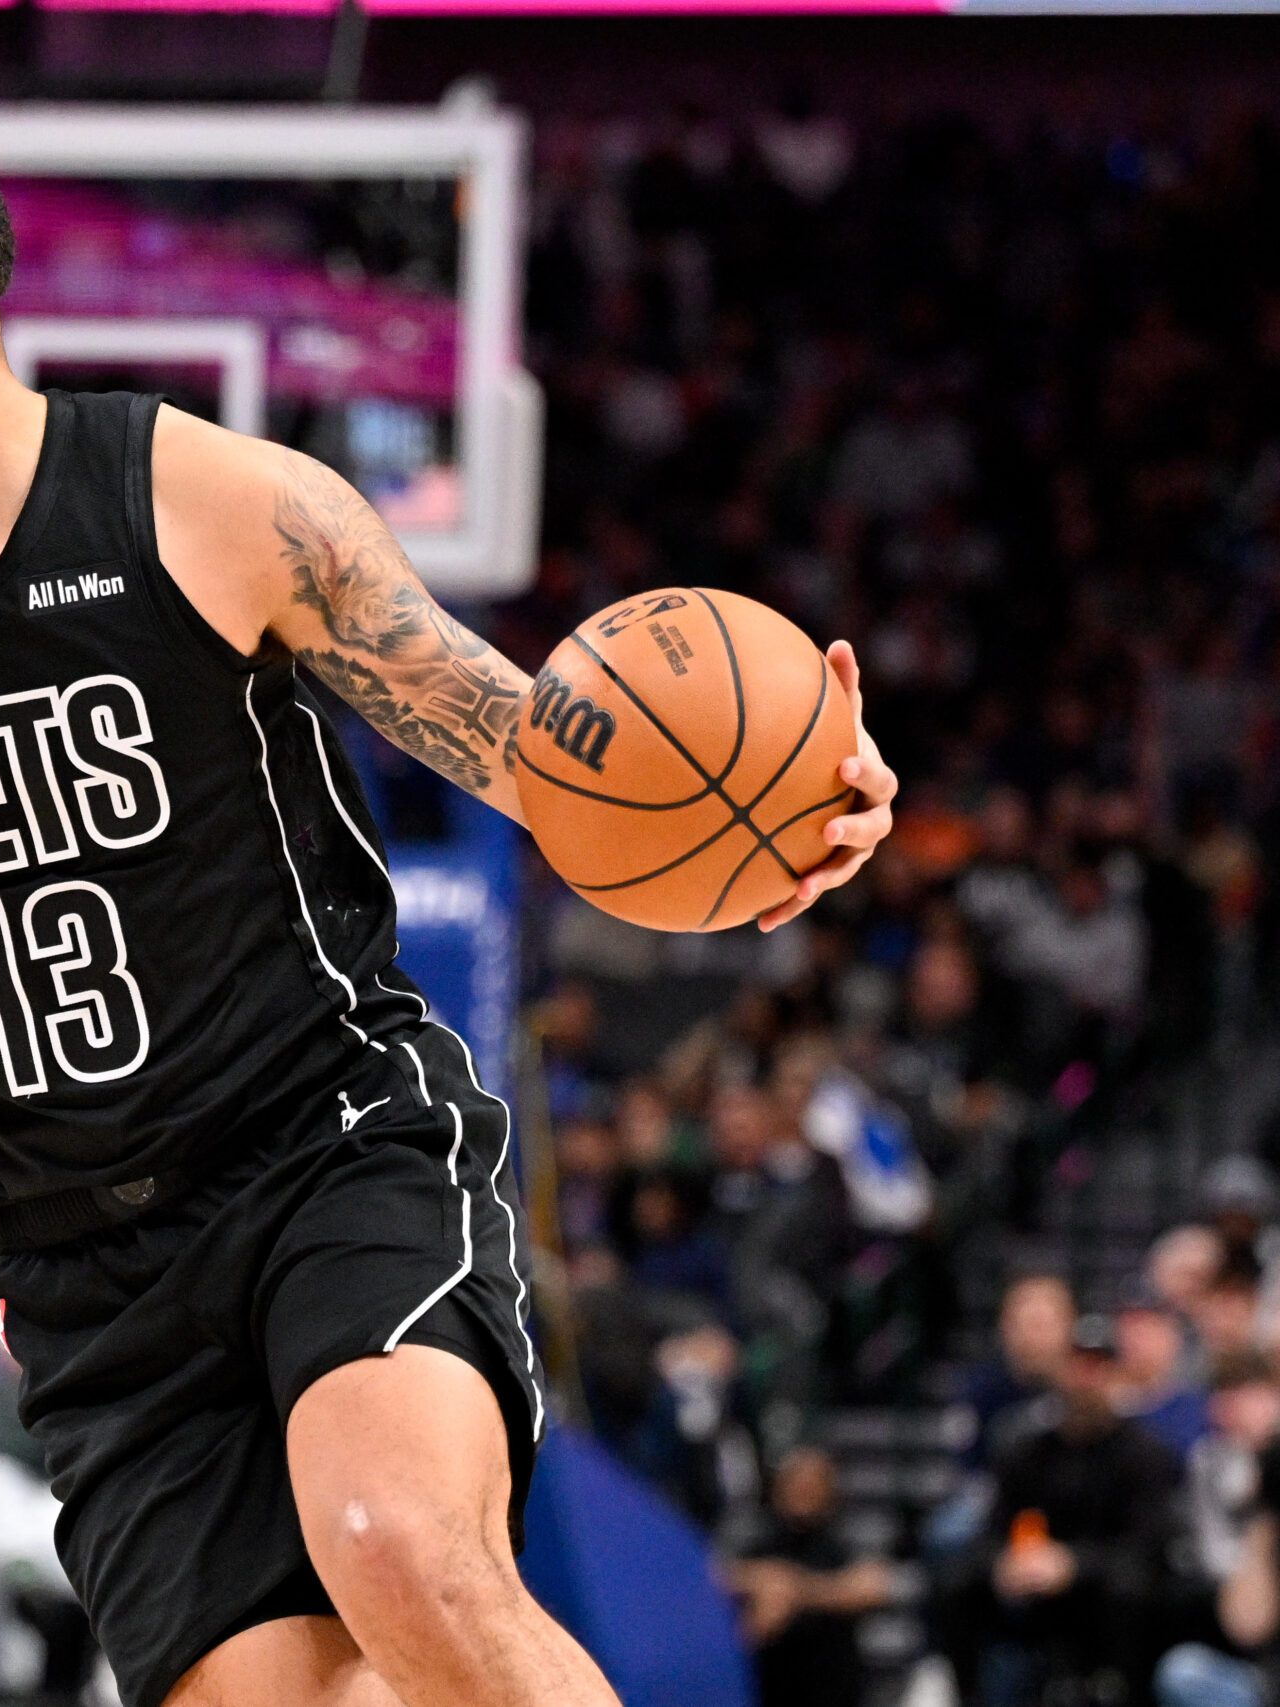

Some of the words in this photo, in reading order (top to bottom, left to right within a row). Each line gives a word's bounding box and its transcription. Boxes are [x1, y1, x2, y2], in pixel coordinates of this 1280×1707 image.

[29, 584, 55, 610] All
[57, 579, 79, 604] In
[78, 572, 125, 600] Won
